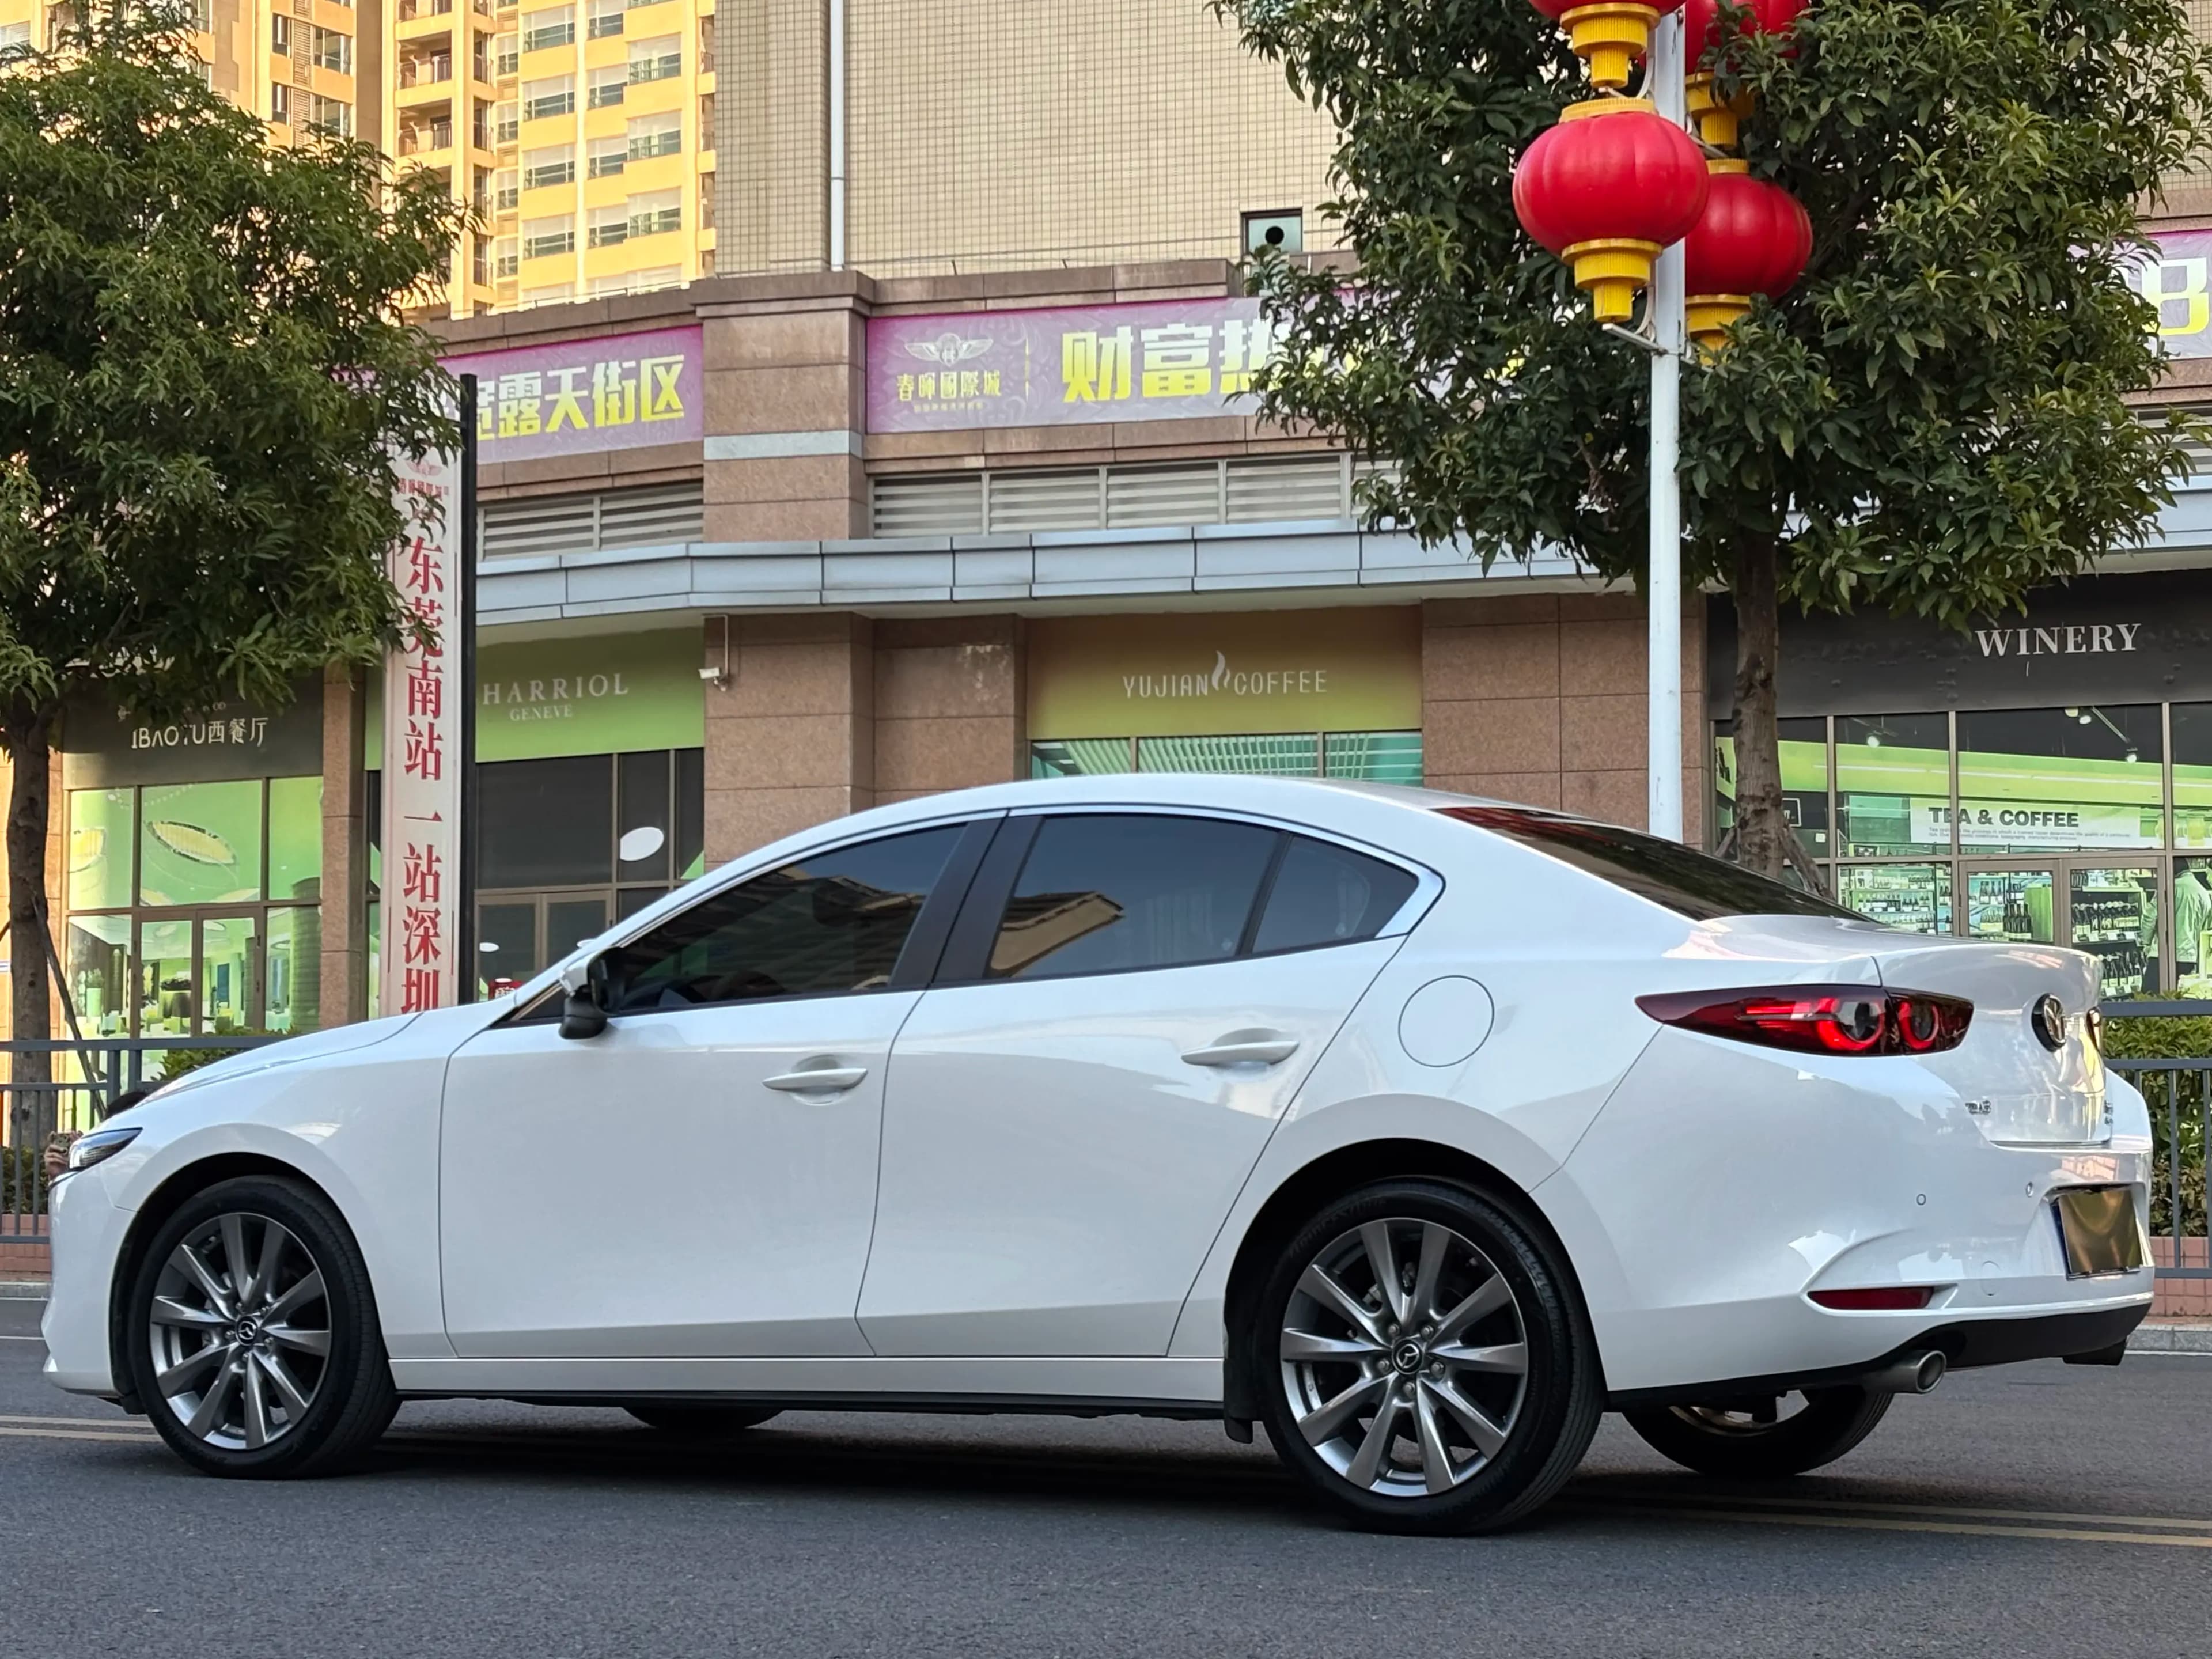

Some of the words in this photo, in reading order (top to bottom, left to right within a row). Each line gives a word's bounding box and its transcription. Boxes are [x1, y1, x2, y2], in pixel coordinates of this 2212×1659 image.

[1974, 623, 2142, 657] WINERY
[1122, 674, 1209, 699] YUJIAN
[1234, 670, 1328, 696] COFFEE
[1928, 807, 1972, 824] TEA
[1978, 809, 1994, 825] &
[1999, 809, 2079, 828] COFFEE
